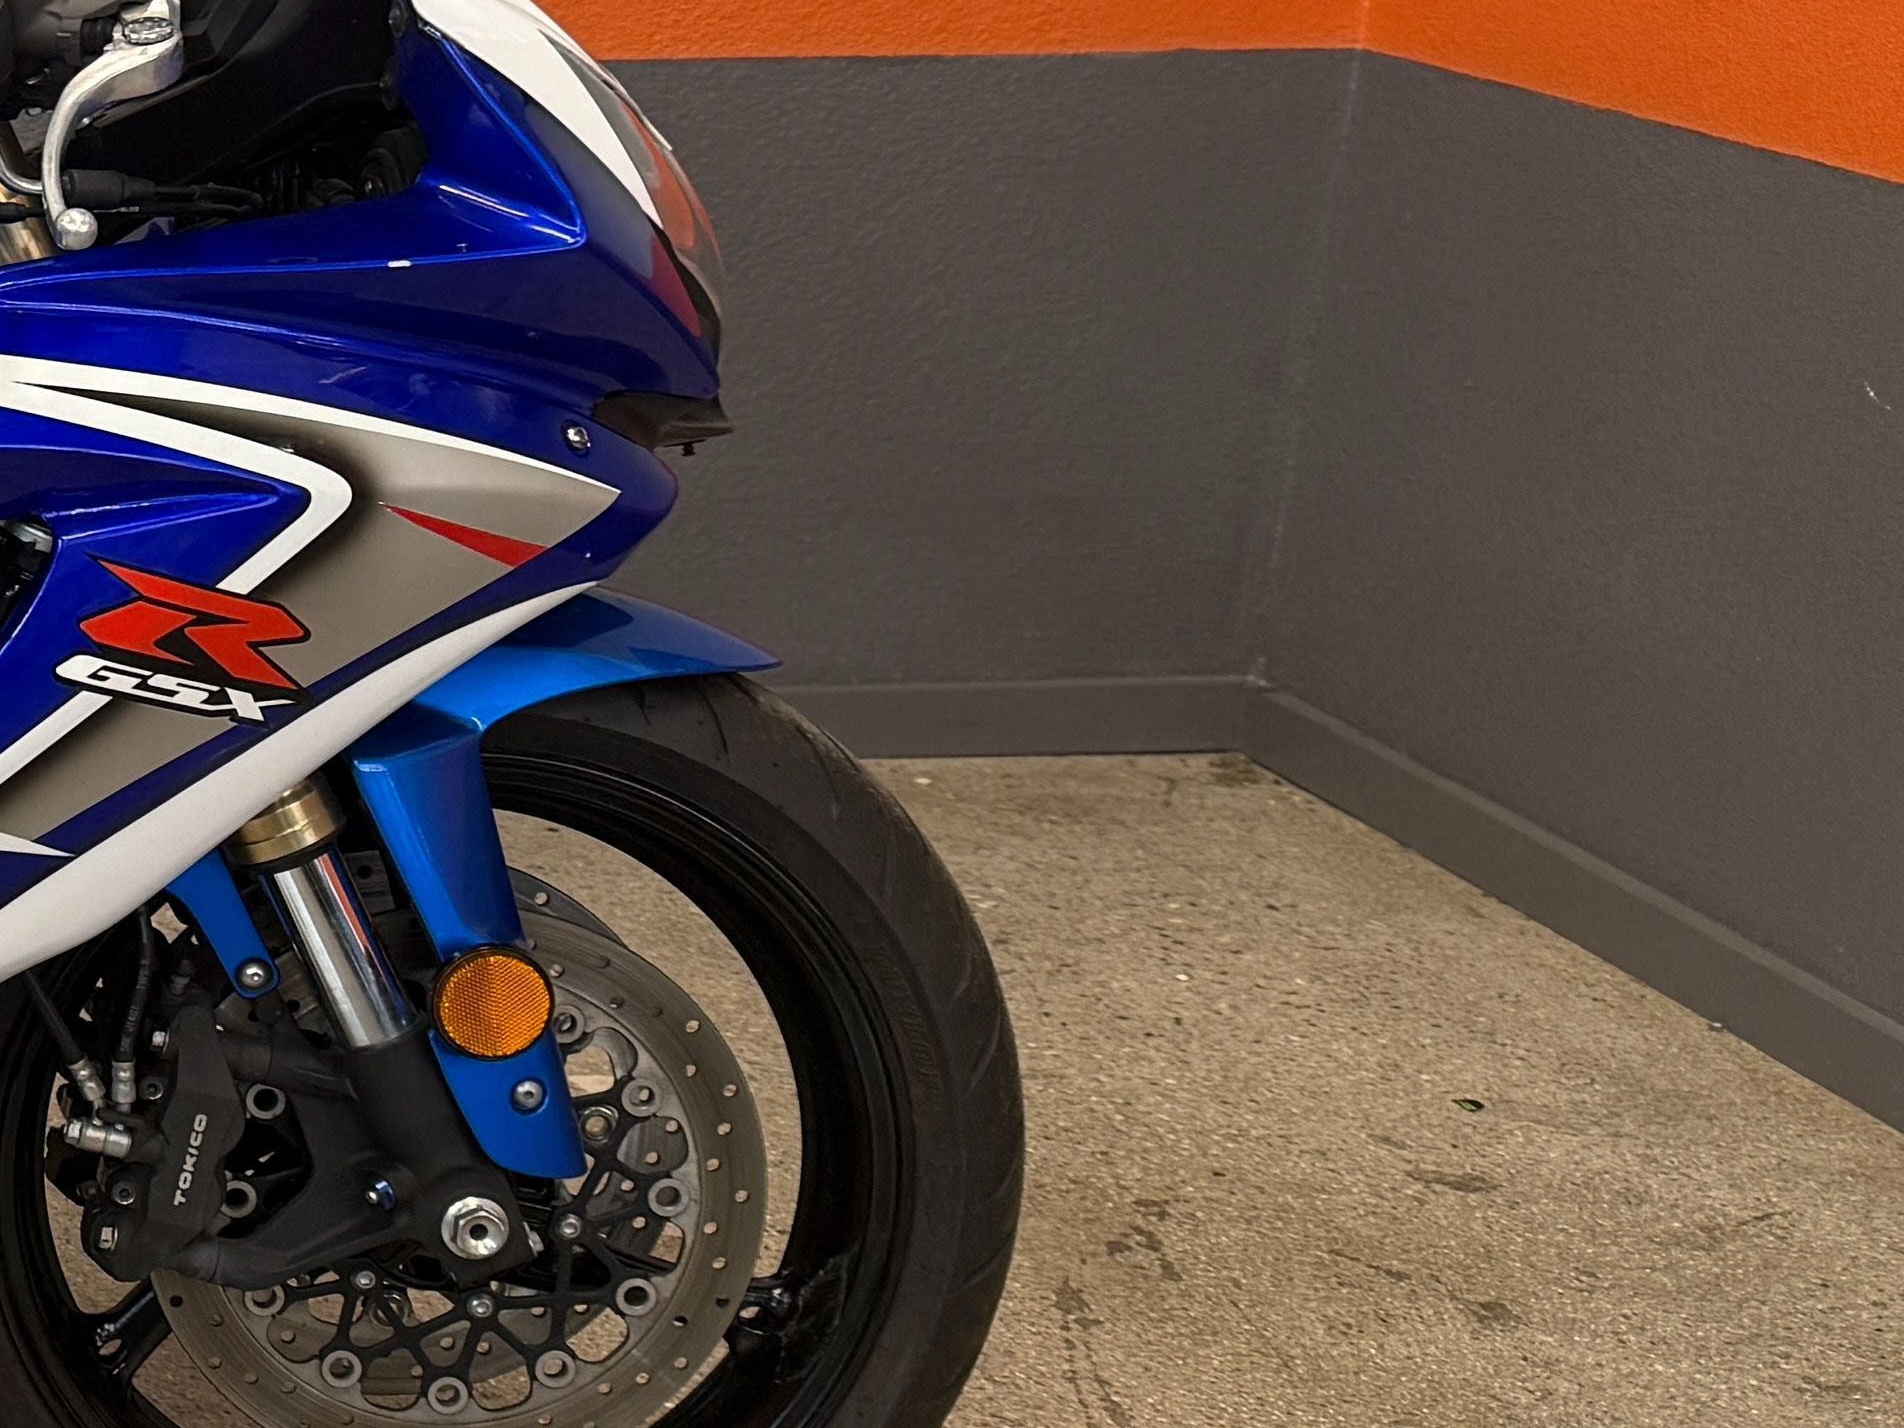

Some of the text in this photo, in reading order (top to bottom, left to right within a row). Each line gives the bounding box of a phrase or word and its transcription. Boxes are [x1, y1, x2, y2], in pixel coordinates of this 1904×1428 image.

[80, 559, 305, 690] R
[55, 654, 296, 722] GSX
[173, 1113, 208, 1206] TOKICO
